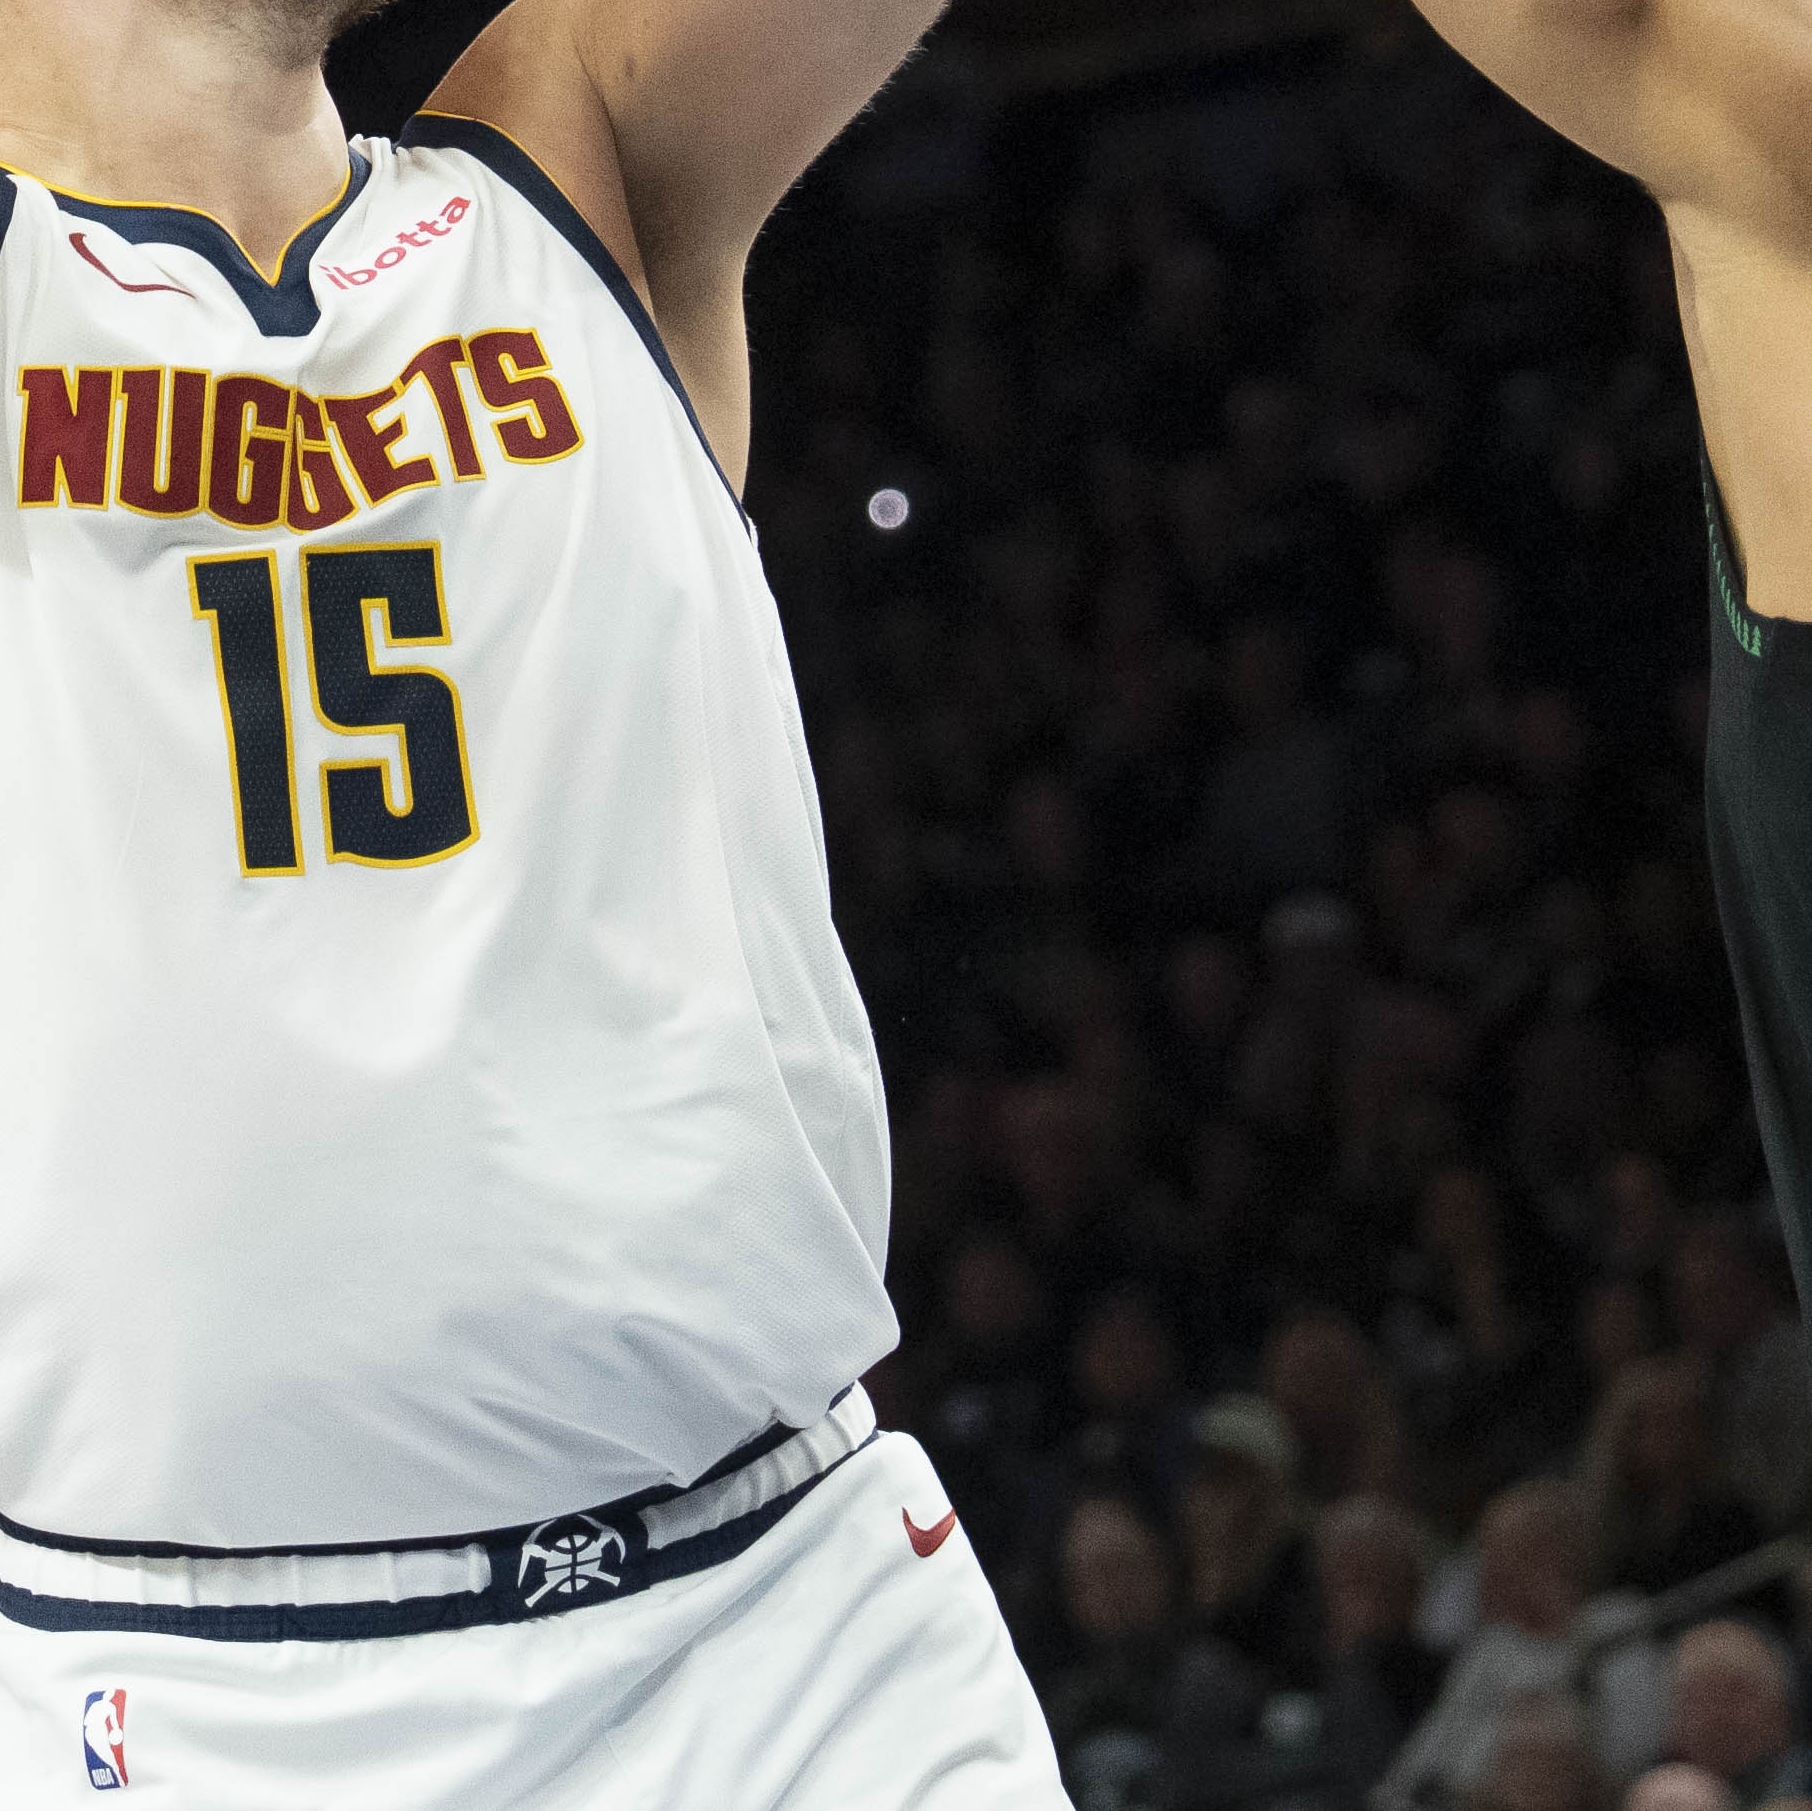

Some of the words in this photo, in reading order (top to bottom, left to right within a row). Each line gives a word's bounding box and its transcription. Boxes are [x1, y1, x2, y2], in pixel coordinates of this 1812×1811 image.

[319, 196, 471, 290] ibotta
[17, 328, 585, 535] NUGGETS
[187, 540, 481, 876] 15
[91, 1767, 115, 1786] NBA
